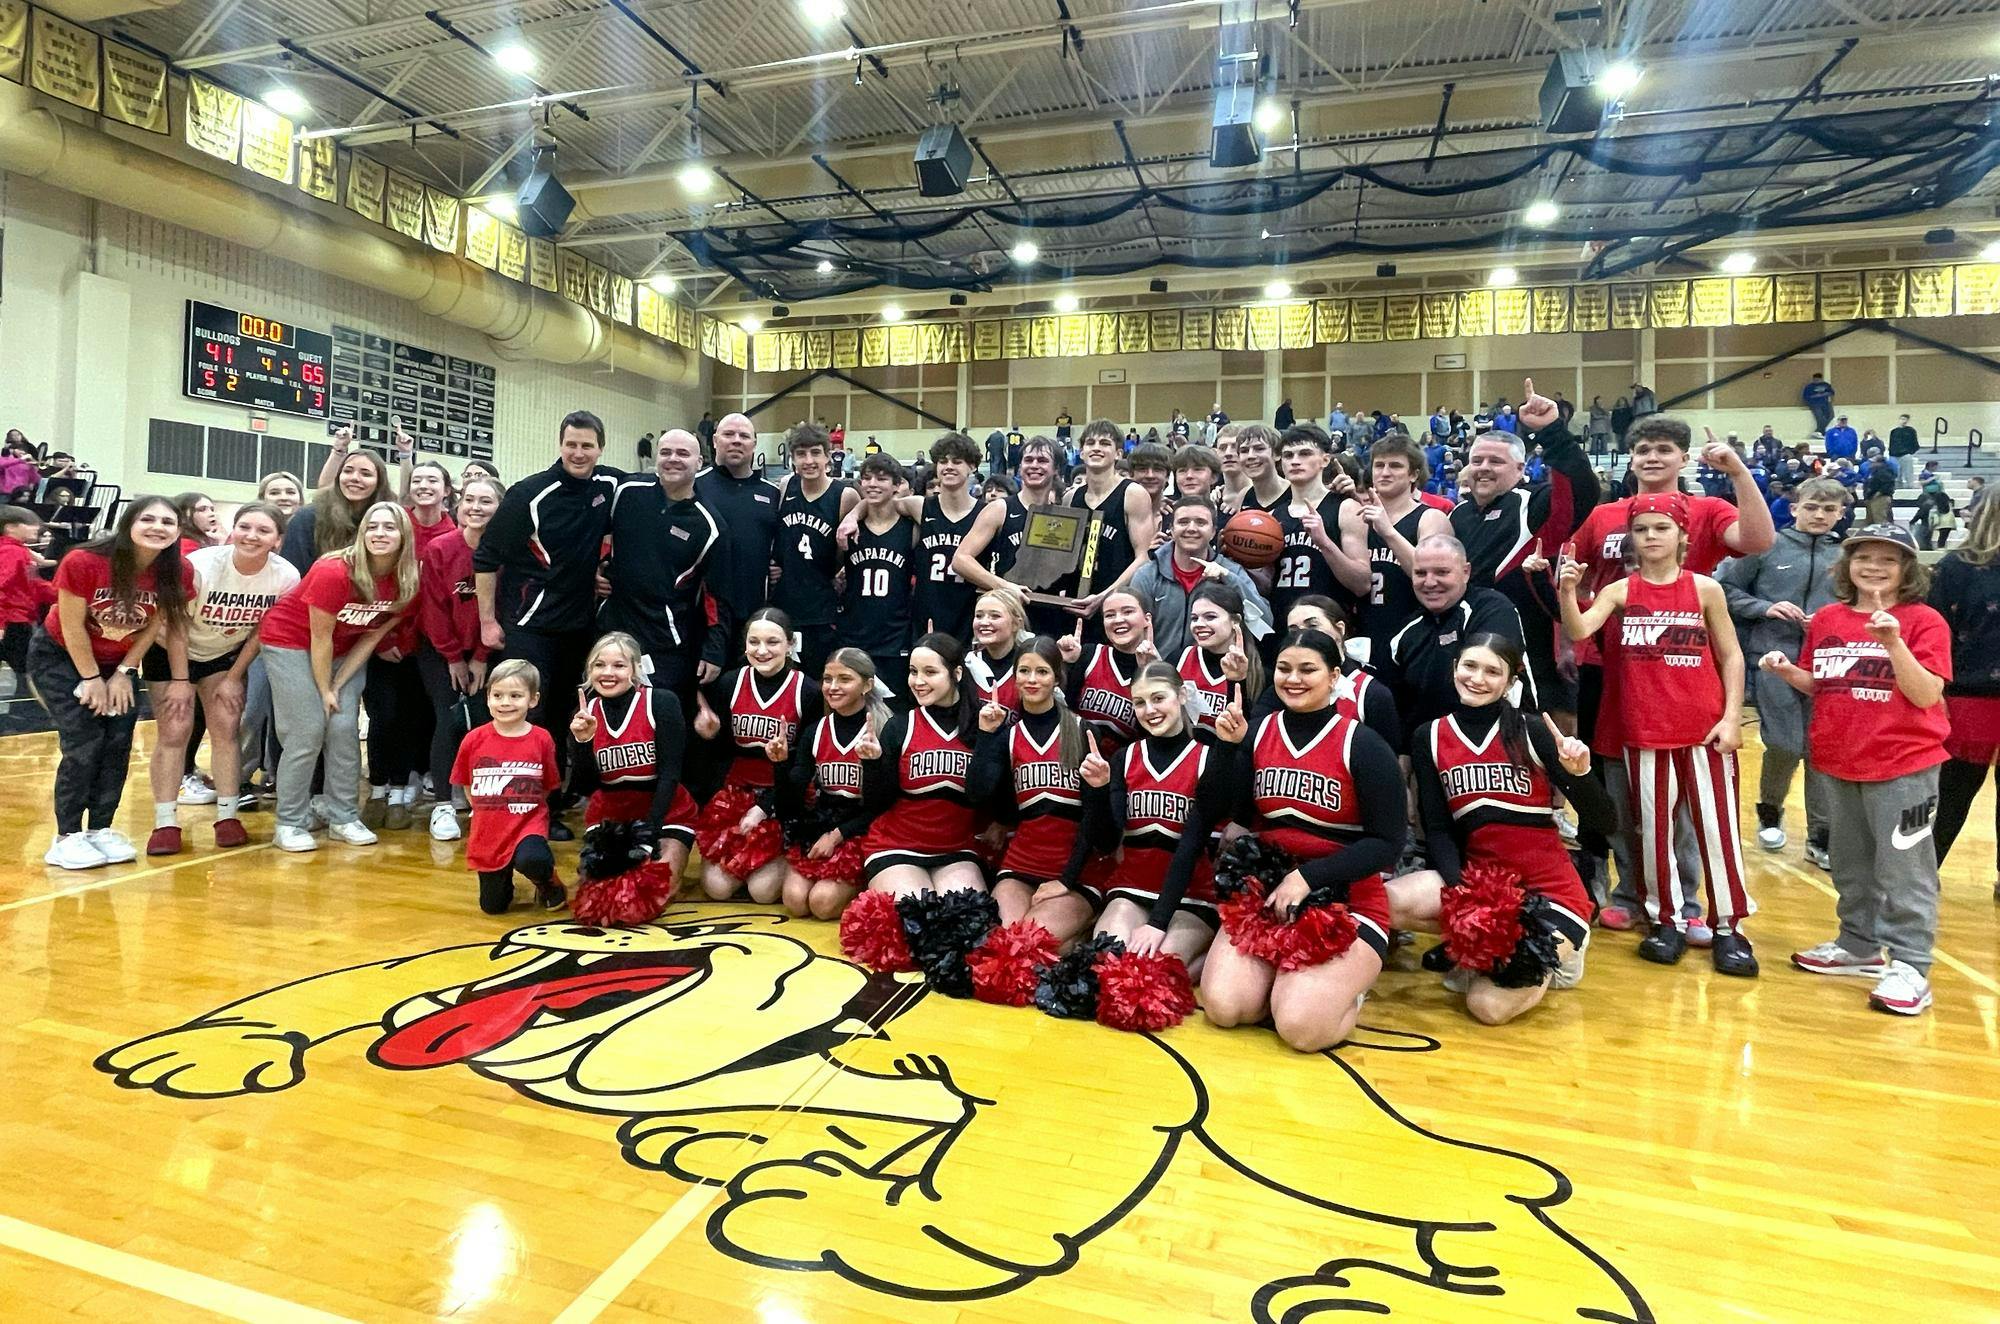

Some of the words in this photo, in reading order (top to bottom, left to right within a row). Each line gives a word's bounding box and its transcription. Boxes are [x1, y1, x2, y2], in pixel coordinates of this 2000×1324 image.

[195, 327, 241, 346] BULLDOGS
[241, 314, 282, 342] 00.0
[206, 342, 233, 365] 41
[298, 351, 323, 364] GUEST
[204, 370, 215, 387] 5
[226, 375, 238, 391] 2
[302, 363, 324, 385] 65
[314, 392, 323, 408] 3
[783, 512, 832, 537] WAPAHANI
[798, 533, 813, 560] 4
[922, 533, 961, 550] WAPAH
[1232, 534, 1273, 551] Wilson
[850, 547, 905, 569] WAPAHANI
[862, 568, 890, 597] 10
[1277, 555, 1311, 588] 22
[1371, 572, 1384, 605] 2
[200, 605, 264, 622] RAIDER
[597, 741, 656, 773] AIDERS
[1255, 767, 1341, 811] RAIDERS
[1440, 763, 1531, 797] RAIDERS
